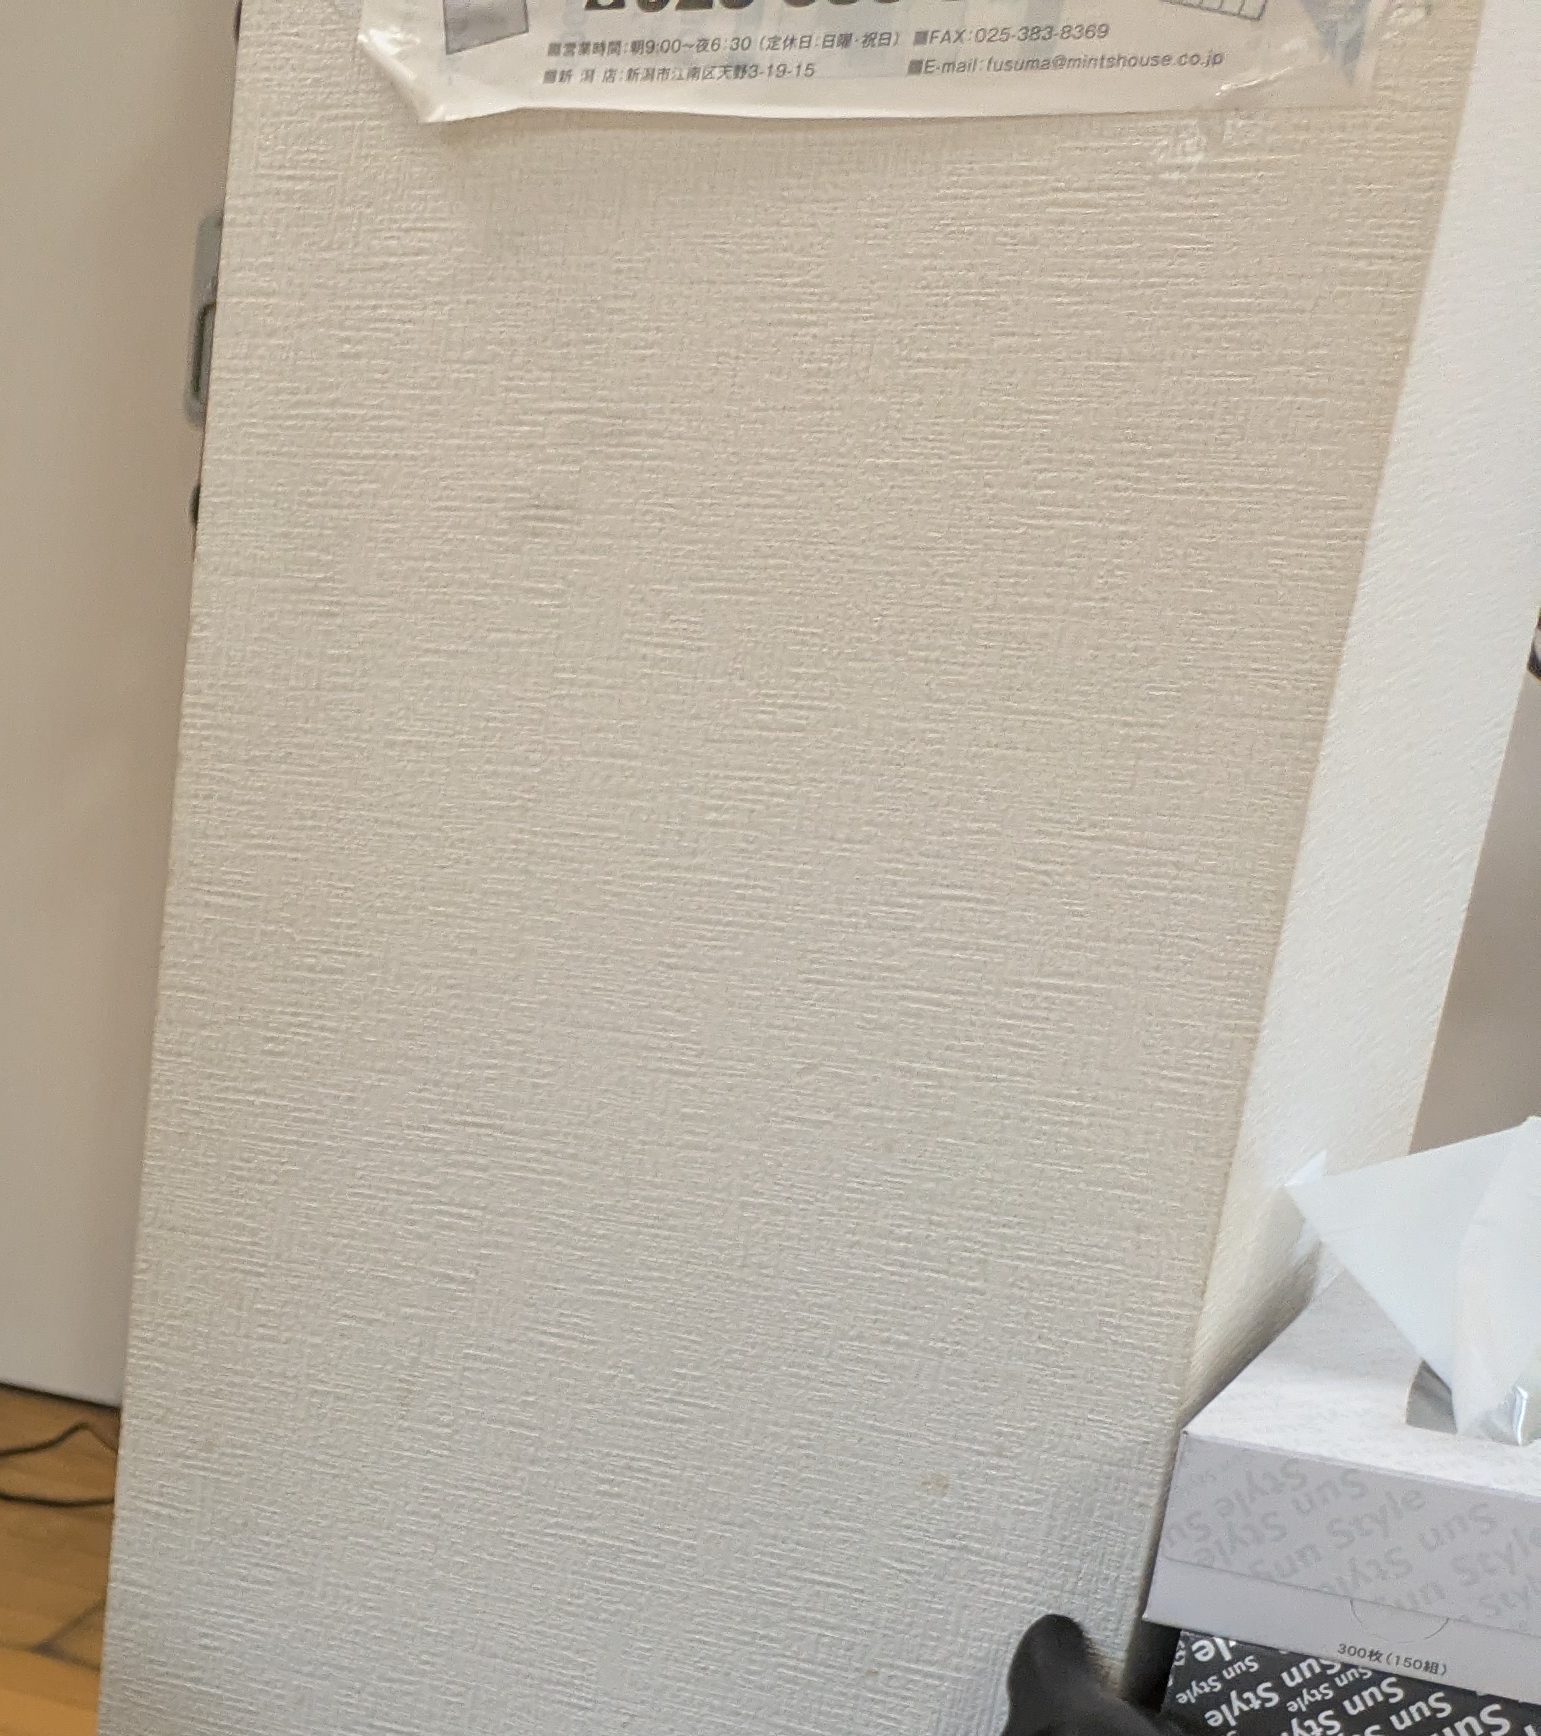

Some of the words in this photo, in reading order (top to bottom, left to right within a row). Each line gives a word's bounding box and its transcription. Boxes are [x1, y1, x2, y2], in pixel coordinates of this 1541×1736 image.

[1222, 1655, 1259, 1680] Sun
[1175, 1675, 1222, 1703] Style
[1204, 1682, 1279, 1726] Style
[1286, 1683, 1334, 1712] Style
[1343, 1677, 1404, 1715] Sun
[1390, 1692, 1452, 1731] Sun
